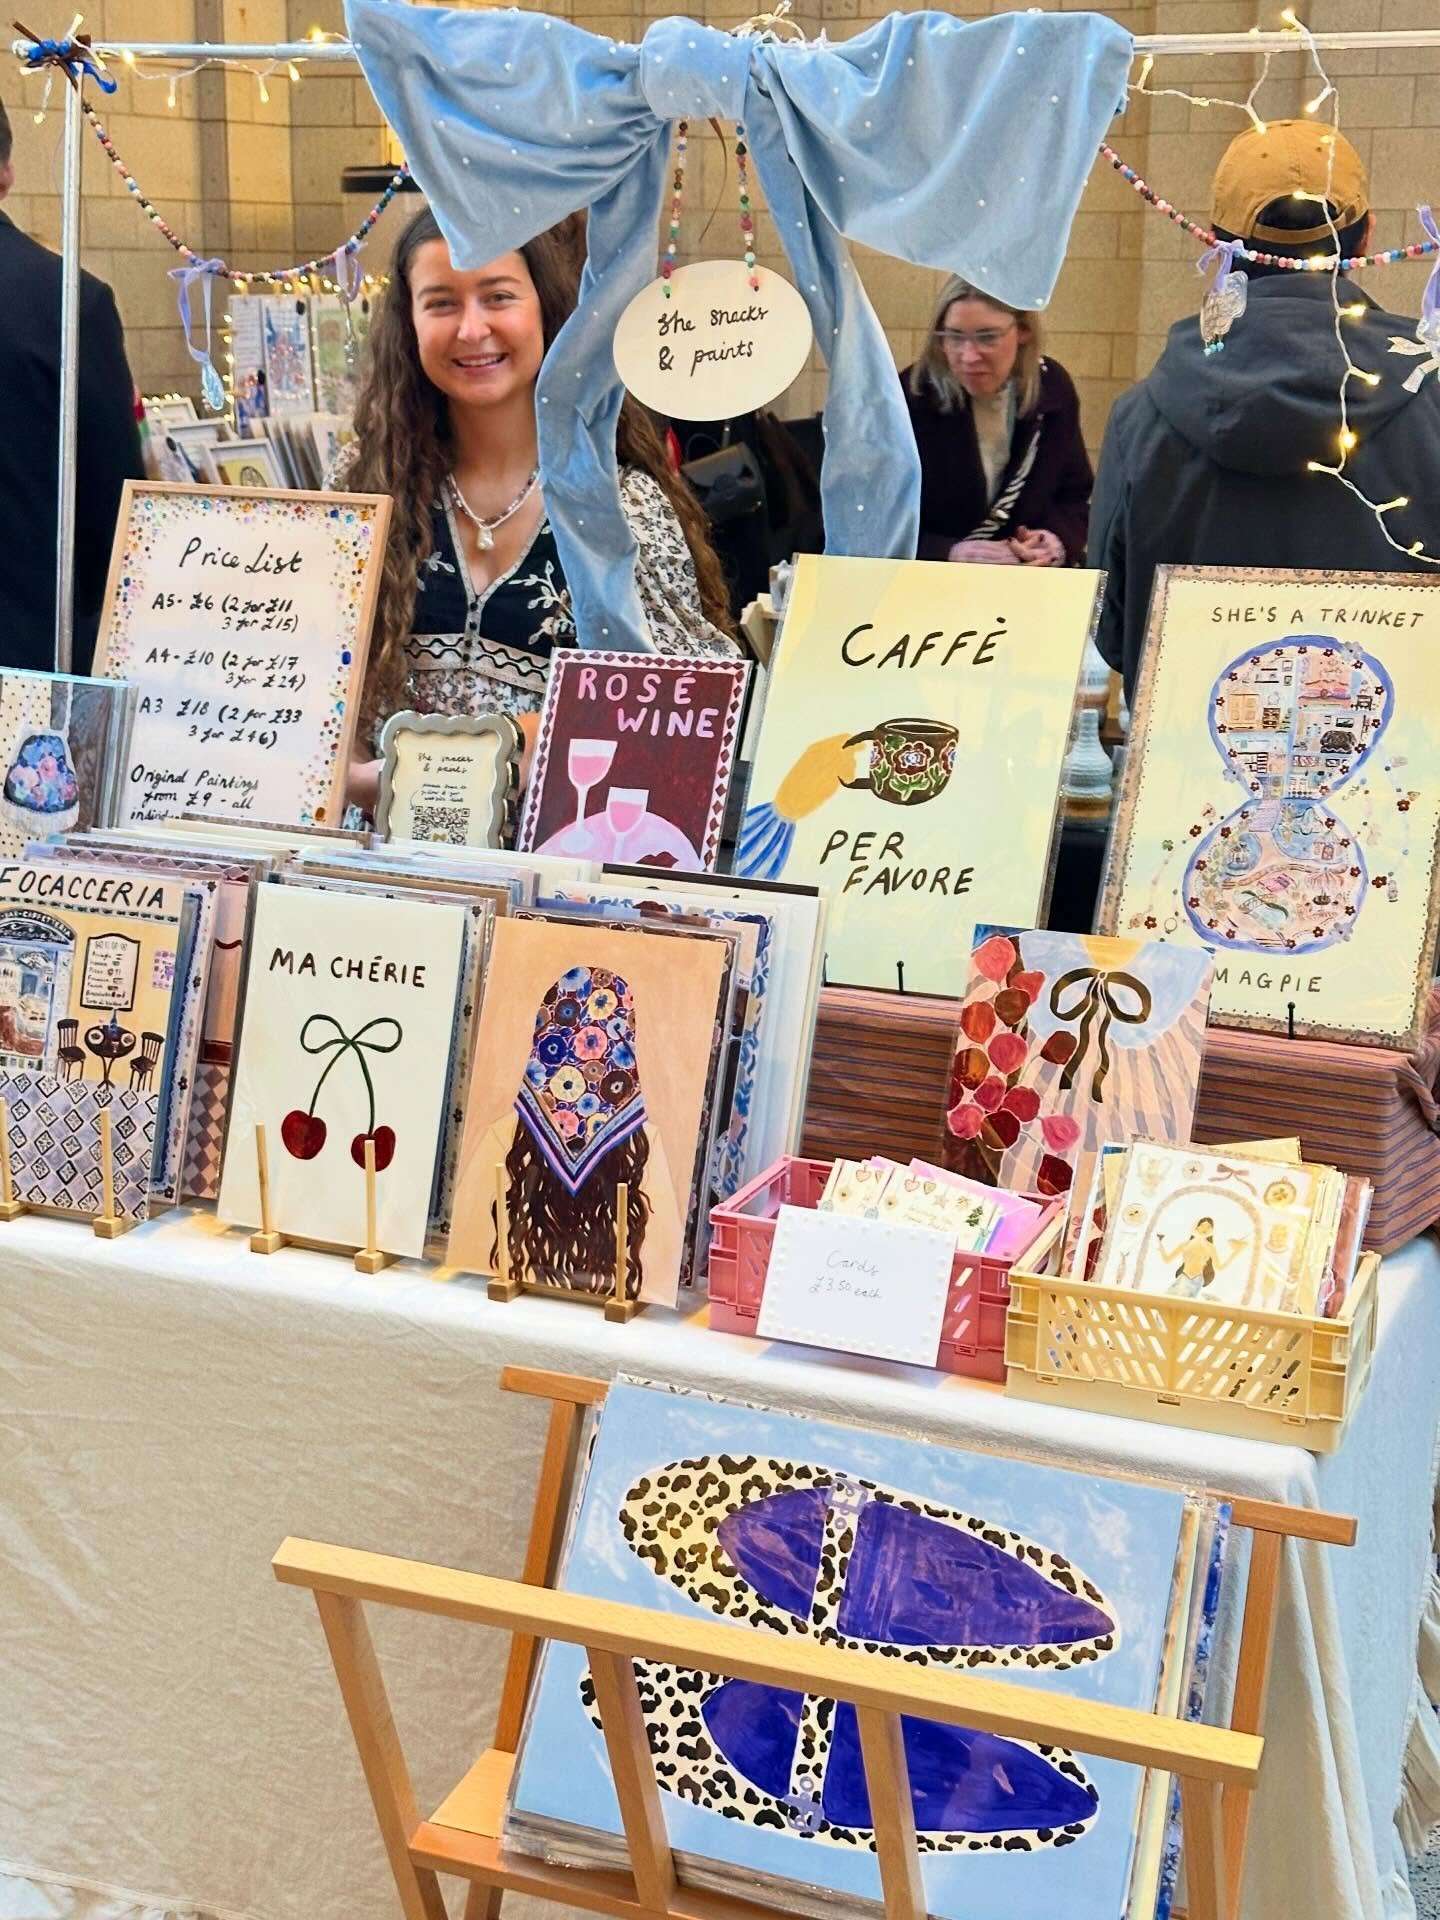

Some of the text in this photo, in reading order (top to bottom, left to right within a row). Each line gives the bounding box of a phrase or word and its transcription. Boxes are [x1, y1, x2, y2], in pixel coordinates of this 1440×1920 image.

[658, 305, 769, 336] She snacks
[658, 341, 753, 377] & paints
[178, 536, 303, 574] Price List
[190, 592, 214, 610] £6
[221, 594, 239, 613] (2
[241, 600, 265, 614] for
[265, 598, 293, 614] £11
[1211, 606, 1425, 628] SHE'S A TRINKET
[221, 614, 299, 633] 3 for £15)
[184, 649, 215, 665] £10
[221, 650, 239, 670] (2
[242, 655, 264, 671] for
[265, 654, 299, 671] £17
[225, 672, 306, 692] 3 for £24)
[577, 667, 697, 705] ROSÉ
[139, 696, 303, 724] A3 £18 (2 for £33
[617, 707, 720, 739] WINE
[188, 725, 277, 750] 3 for £46)
[131, 764, 259, 796] Original Paintings
[141, 791, 177, 808] from
[186, 790, 212, 807] £9
[232, 796, 254, 809] all
[819, 829, 905, 864] PER
[0, 867, 164, 909] FOCACCERIA
[842, 865, 975, 895] FAVORE
[269, 948, 427, 988] MA CHÉRIE
[1211, 967, 1322, 992] MAGPIE
[826, 1249, 880, 1276] Cards
[854, 1287, 883, 1299] each
